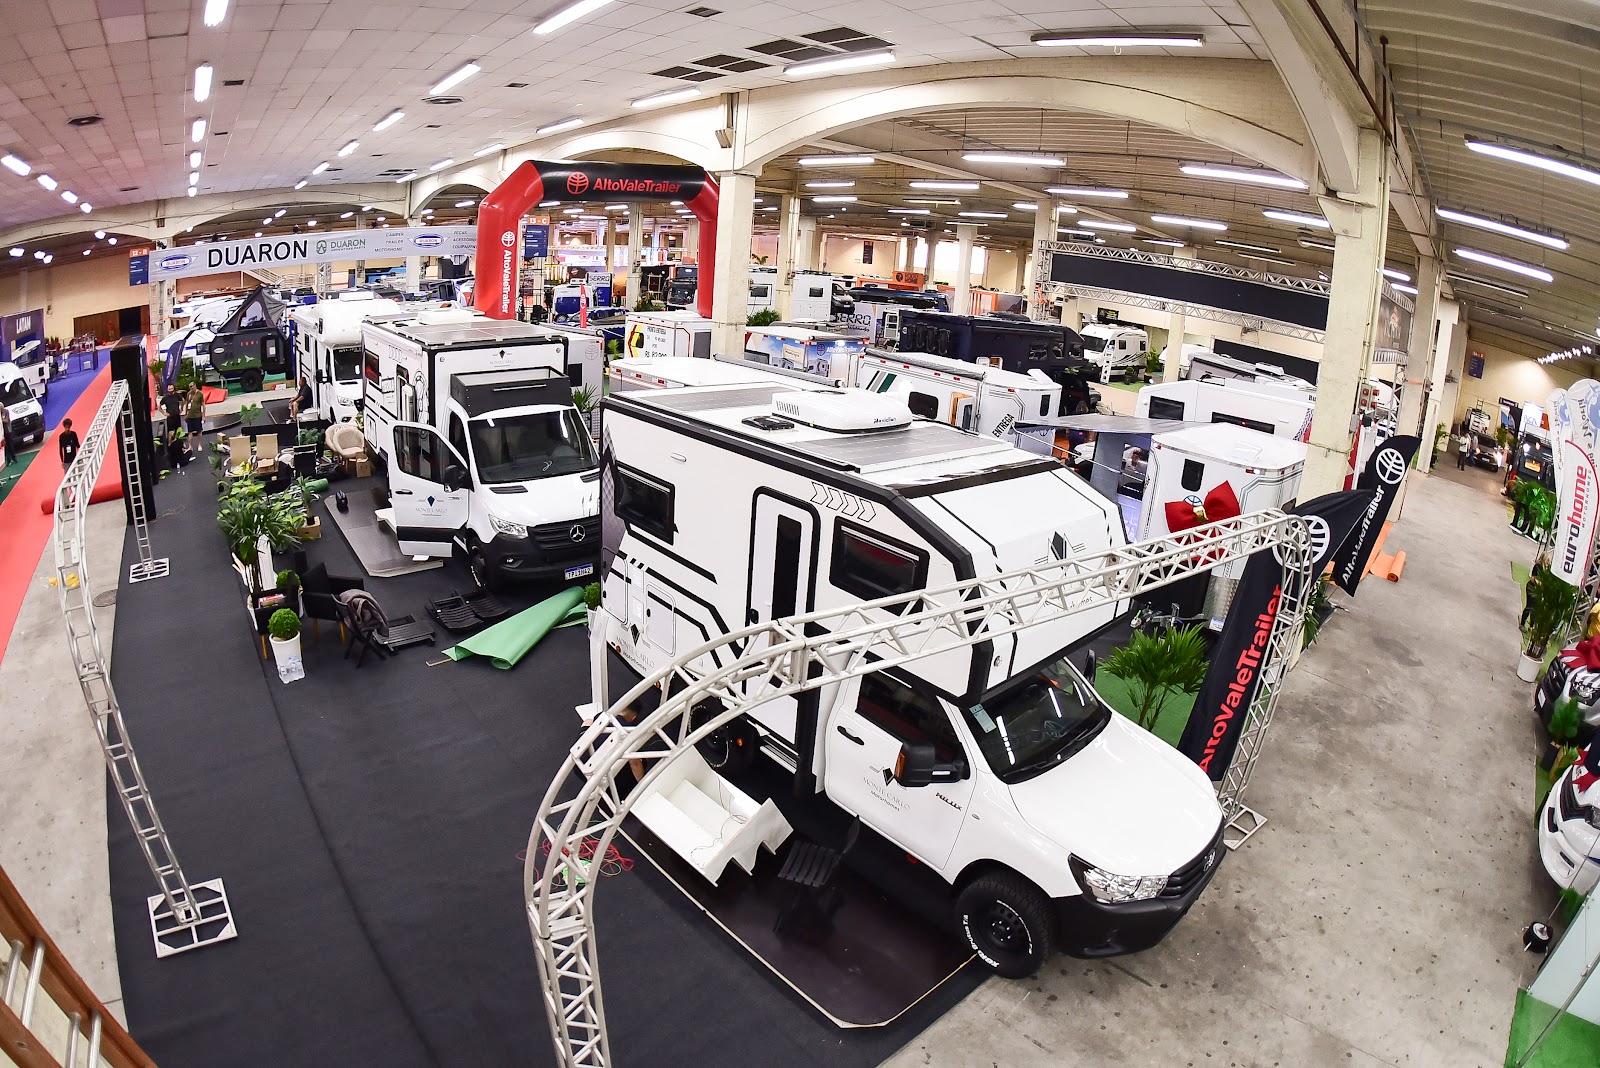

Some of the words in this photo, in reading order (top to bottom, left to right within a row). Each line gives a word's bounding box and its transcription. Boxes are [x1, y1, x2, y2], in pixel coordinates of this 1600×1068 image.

[593, 178, 681, 193] AltoValeTrailer
[207, 240, 308, 268] DUARON
[330, 238, 366, 249] DUARON
[501, 250, 511, 314] AltoValeTrailer
[992, 413, 1015, 438] ENTREGA
[1581, 469, 1592, 529] MOTORHOMES
[1563, 465, 1588, 575] eurohome
[935, 791, 963, 811] HILUX
